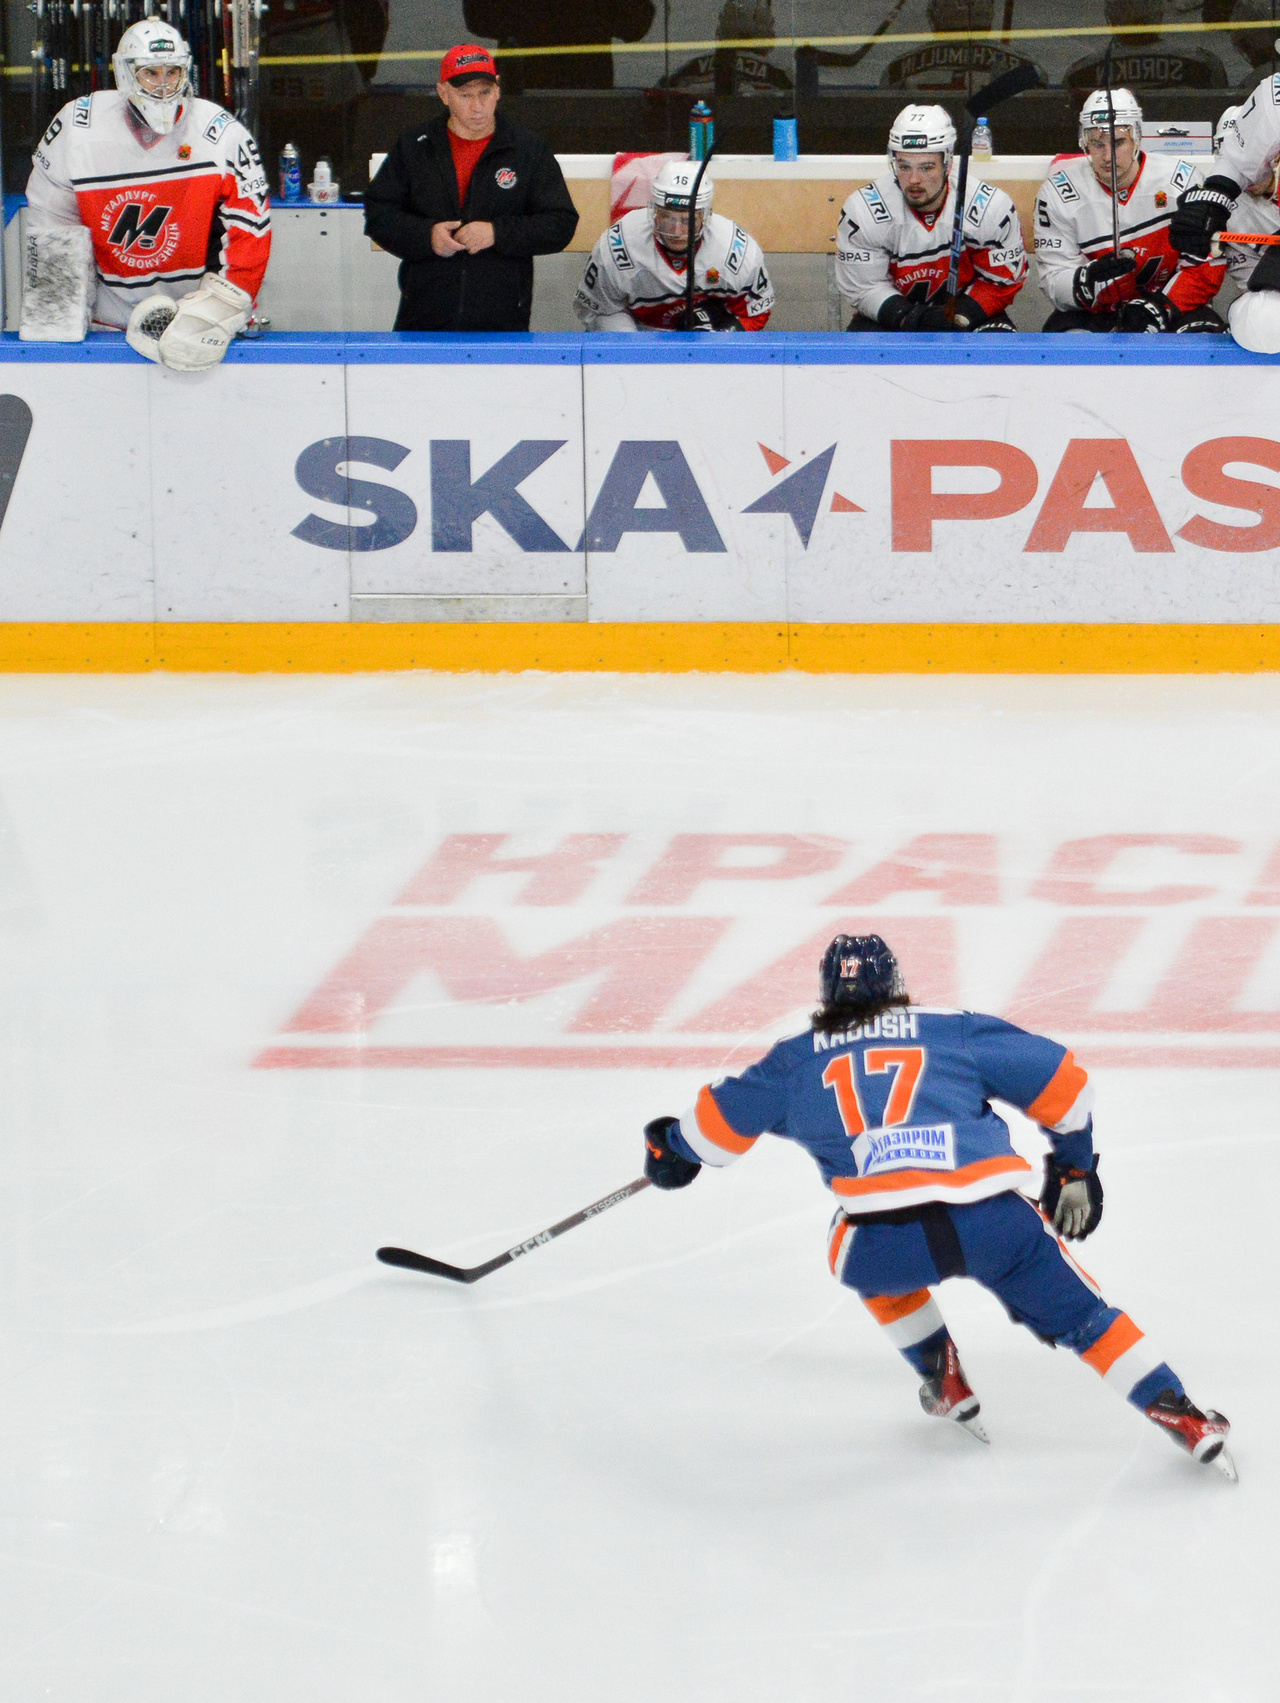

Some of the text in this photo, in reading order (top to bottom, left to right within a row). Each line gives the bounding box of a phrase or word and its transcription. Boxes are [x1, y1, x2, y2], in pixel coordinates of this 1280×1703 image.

[911, 113, 925, 122] 77
[903, 138, 926, 146] PARI
[100, 190, 157, 232] МЕТАЛЛУРГ
[111, 222, 181, 268] НОВОКУЗНЕЦК
[289, 435, 728, 553] SKA
[840, 959, 859, 979] 17
[822, 1047, 925, 1137] 17
[878, 1129, 946, 1154] ГАЗПРОМ
[508, 1229, 553, 1261] CCM
